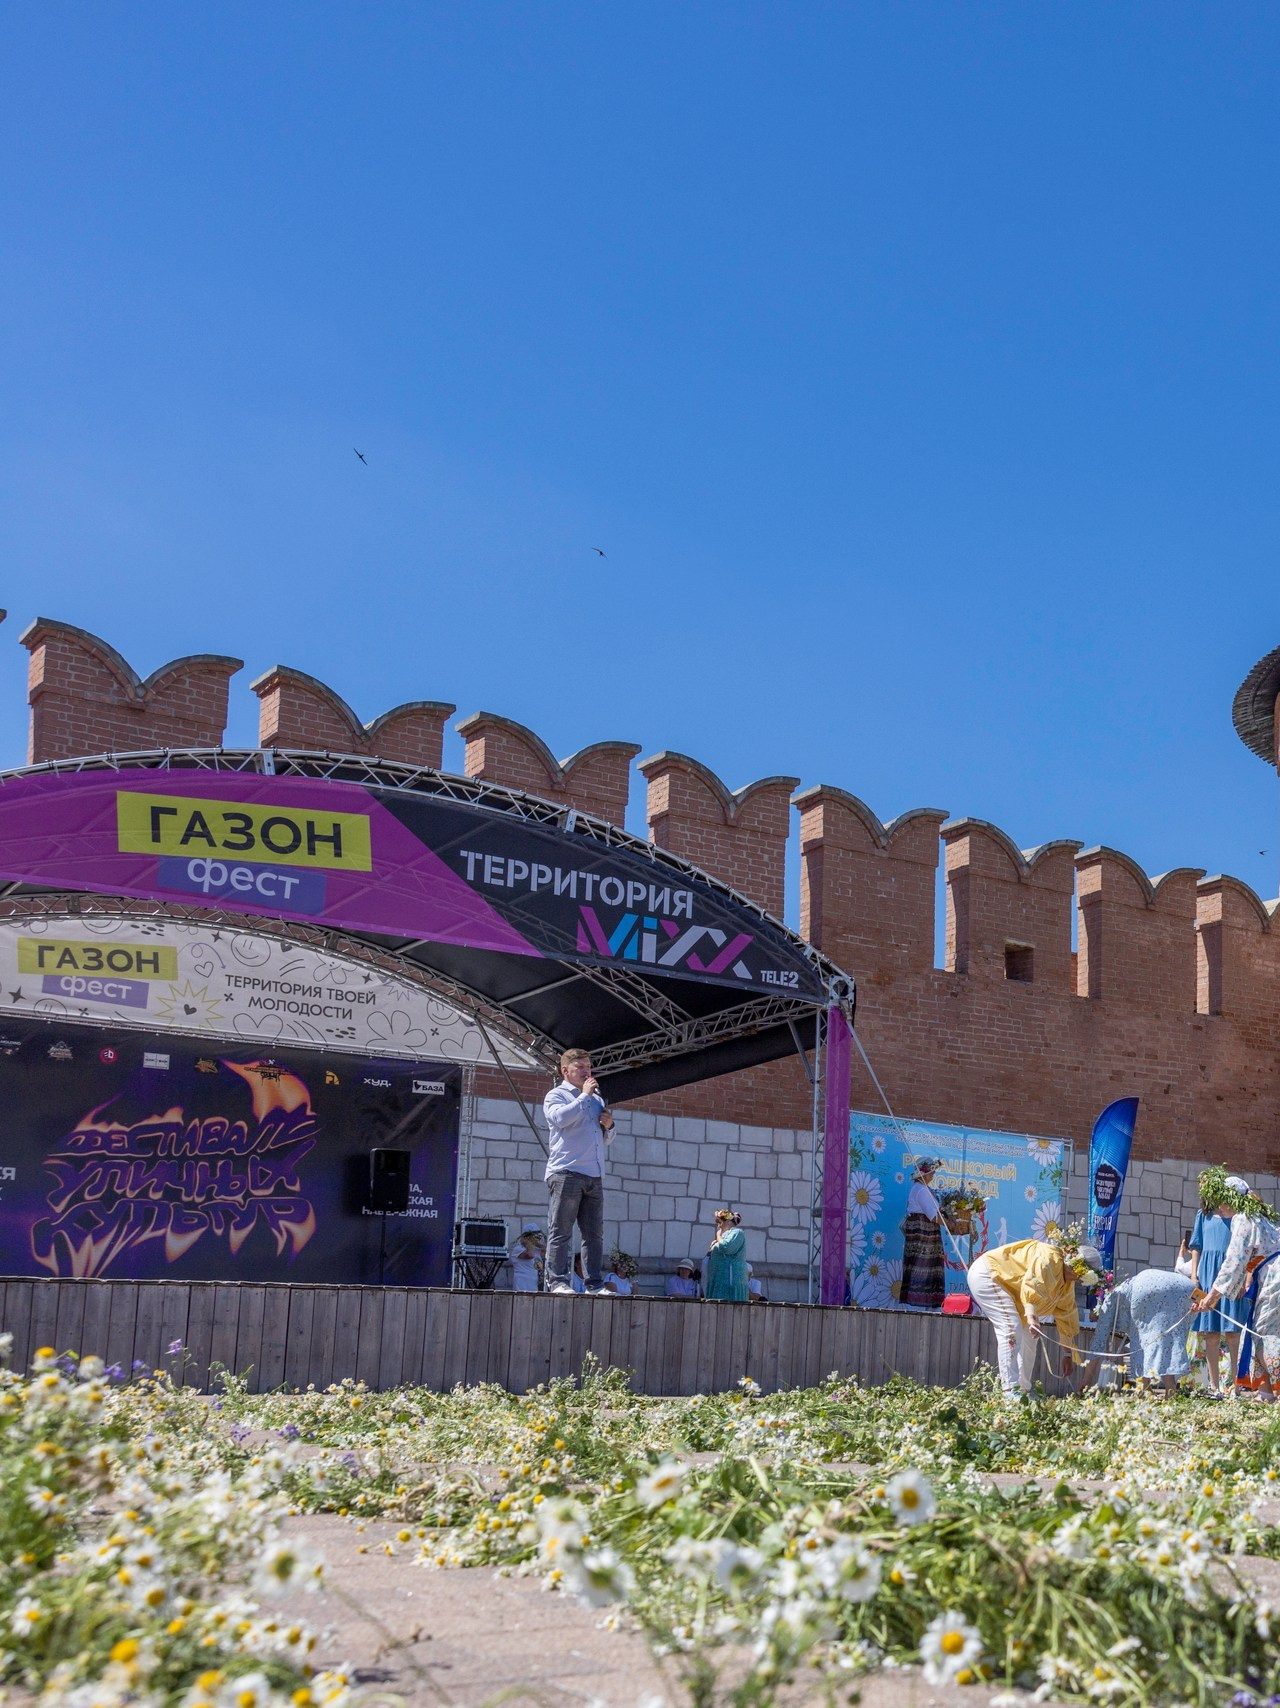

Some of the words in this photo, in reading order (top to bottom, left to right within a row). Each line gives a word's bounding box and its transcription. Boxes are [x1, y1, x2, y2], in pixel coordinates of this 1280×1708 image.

[150, 806, 343, 858] ГАЗОН
[187, 857, 300, 899] фест
[460, 850, 694, 919] ТЕРРИТОРИЯ
[37, 945, 160, 974] ГАЗОН
[60, 975, 132, 1000] фест
[225, 974, 322, 999] ТЕРРИТОРИЯ
[326, 987, 377, 1006] ТВОЕЙ
[760, 970, 800, 989] TELE2
[248, 997, 354, 1020] МОЛОДОСТИ
[903, 1153, 1017, 1181] РАШКОВЫЙ
